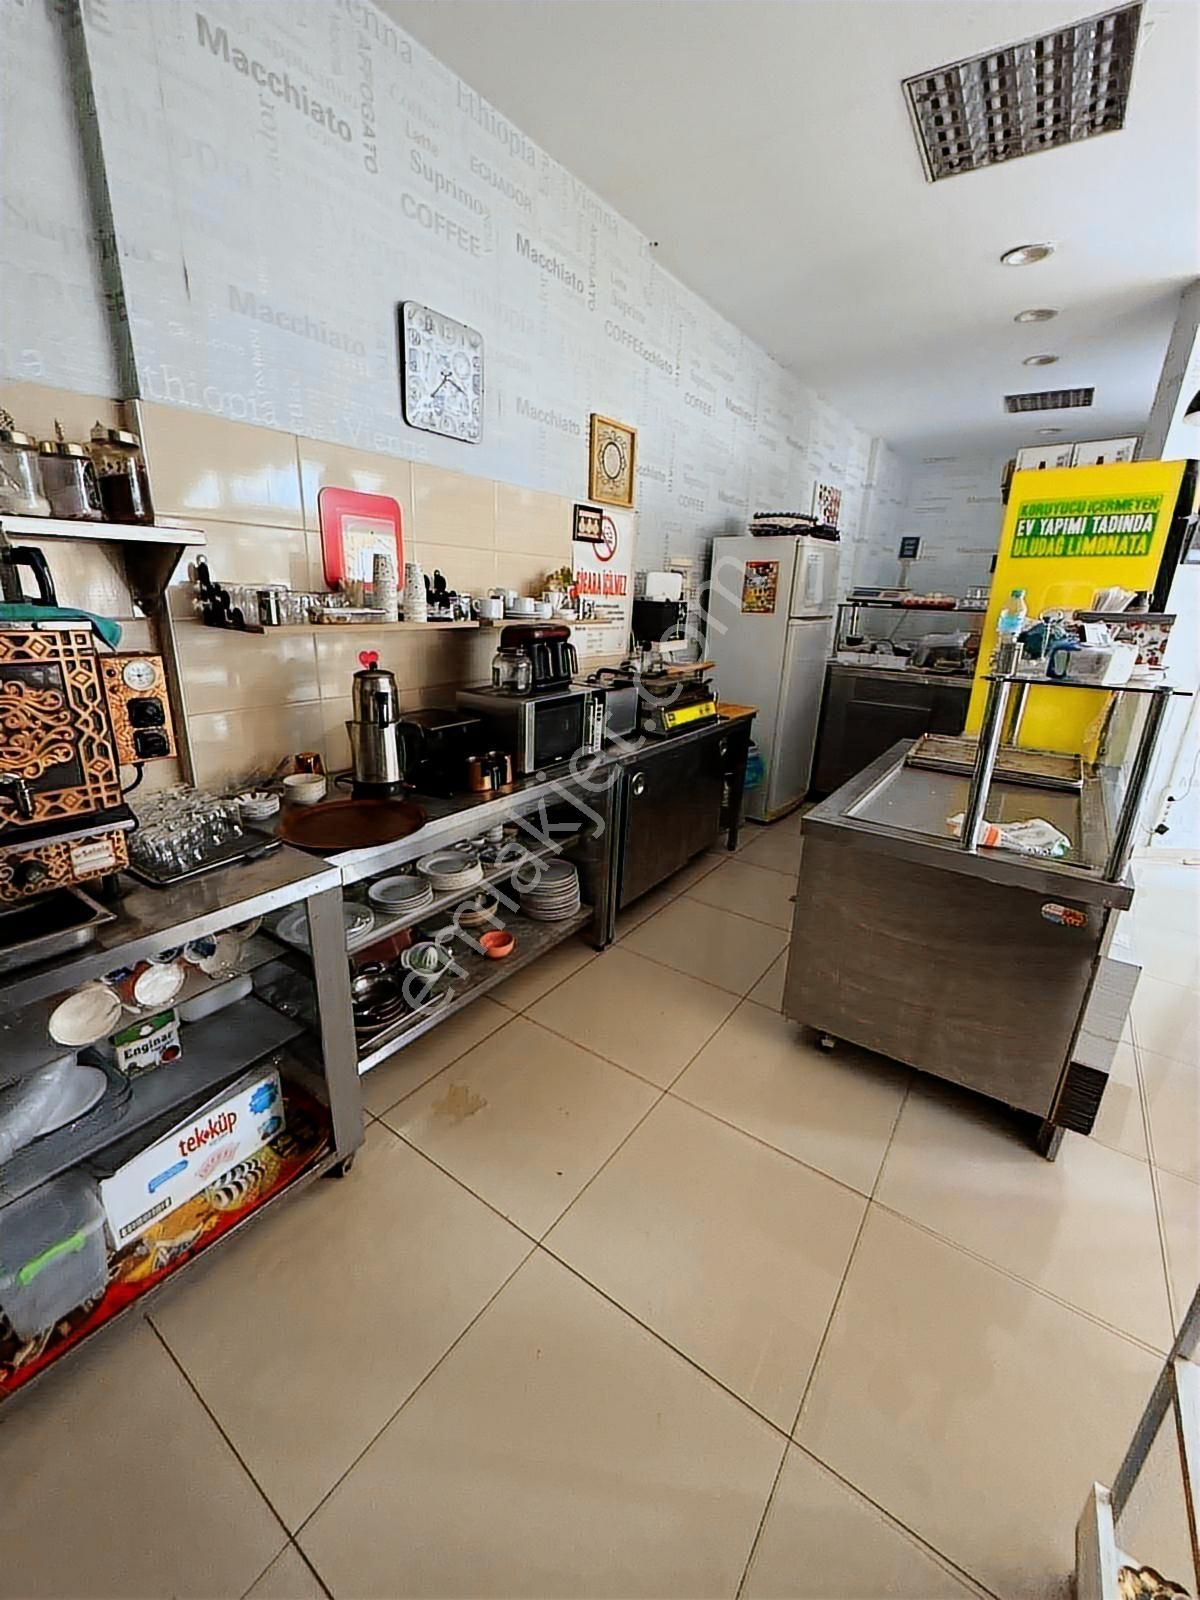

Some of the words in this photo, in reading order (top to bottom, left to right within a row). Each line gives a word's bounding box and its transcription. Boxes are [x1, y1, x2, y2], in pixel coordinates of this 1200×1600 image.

[195, 12, 353, 143] Macchiato
[410, 148, 485, 216] Suprimo
[401, 192, 482, 259] COFFEE
[516, 231, 586, 294] Macchiato
[227, 284, 367, 358] Macchiato
[515, 396, 582, 437] Macchiato
[1017, 518, 1036, 537] EV
[1040, 516, 1087, 536] YAPIMI
[1092, 513, 1153, 534] TADINDA
[123, 1031, 175, 1060] Enginar
